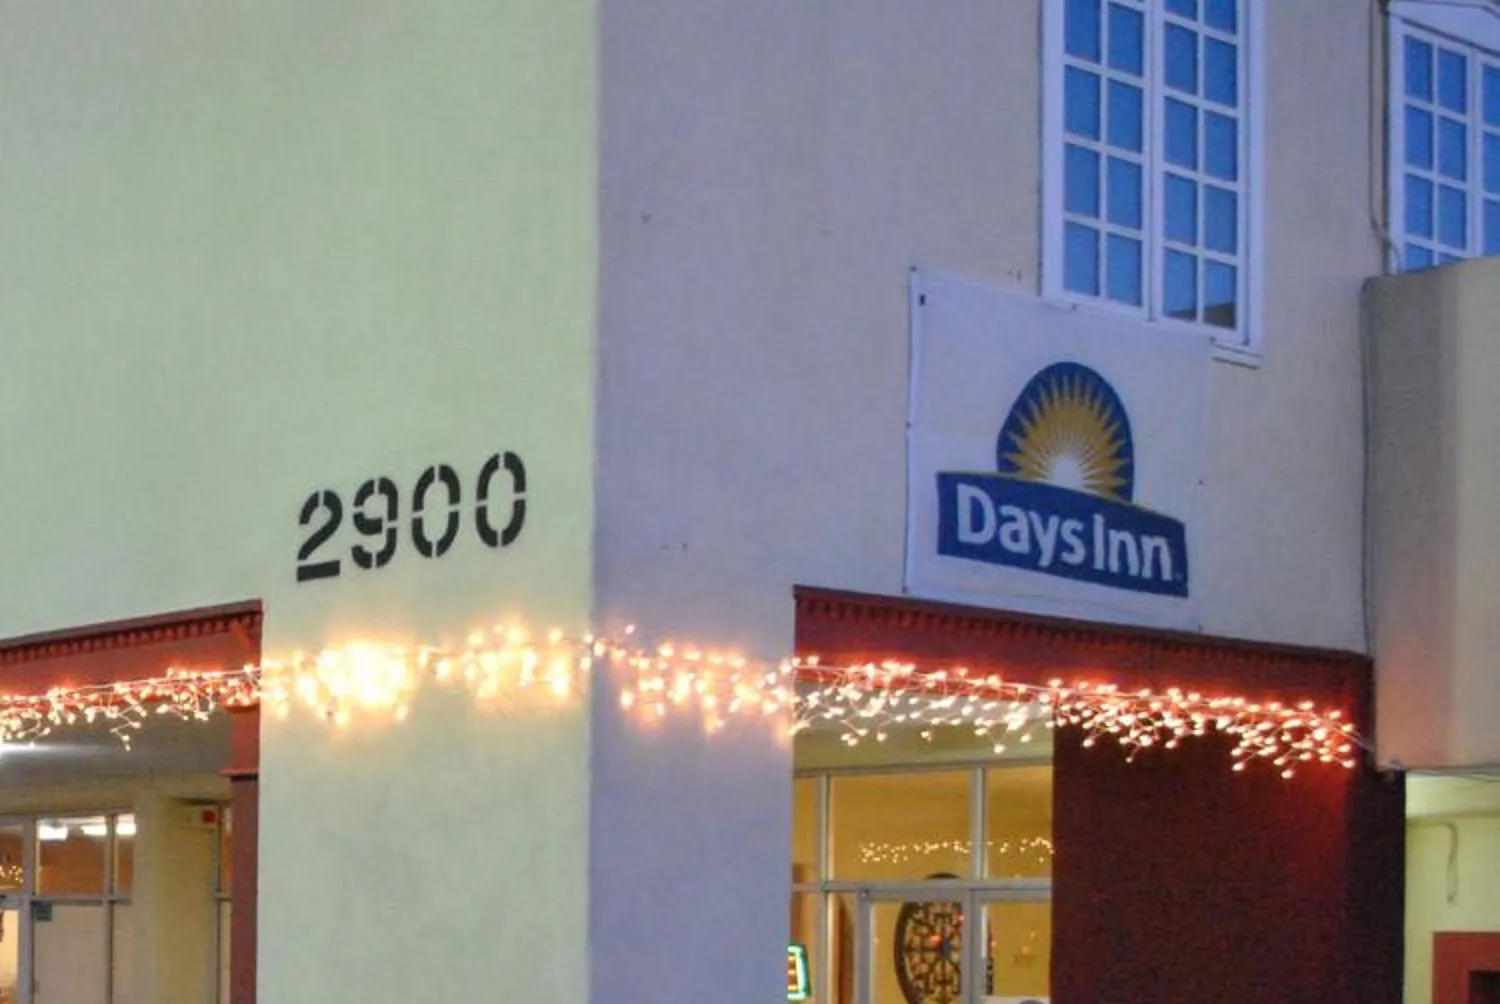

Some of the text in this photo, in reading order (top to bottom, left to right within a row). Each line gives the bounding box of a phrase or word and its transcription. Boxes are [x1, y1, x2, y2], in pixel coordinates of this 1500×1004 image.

[296, 450, 527, 582] 2900
[956, 483, 1173, 582] Days Inn
